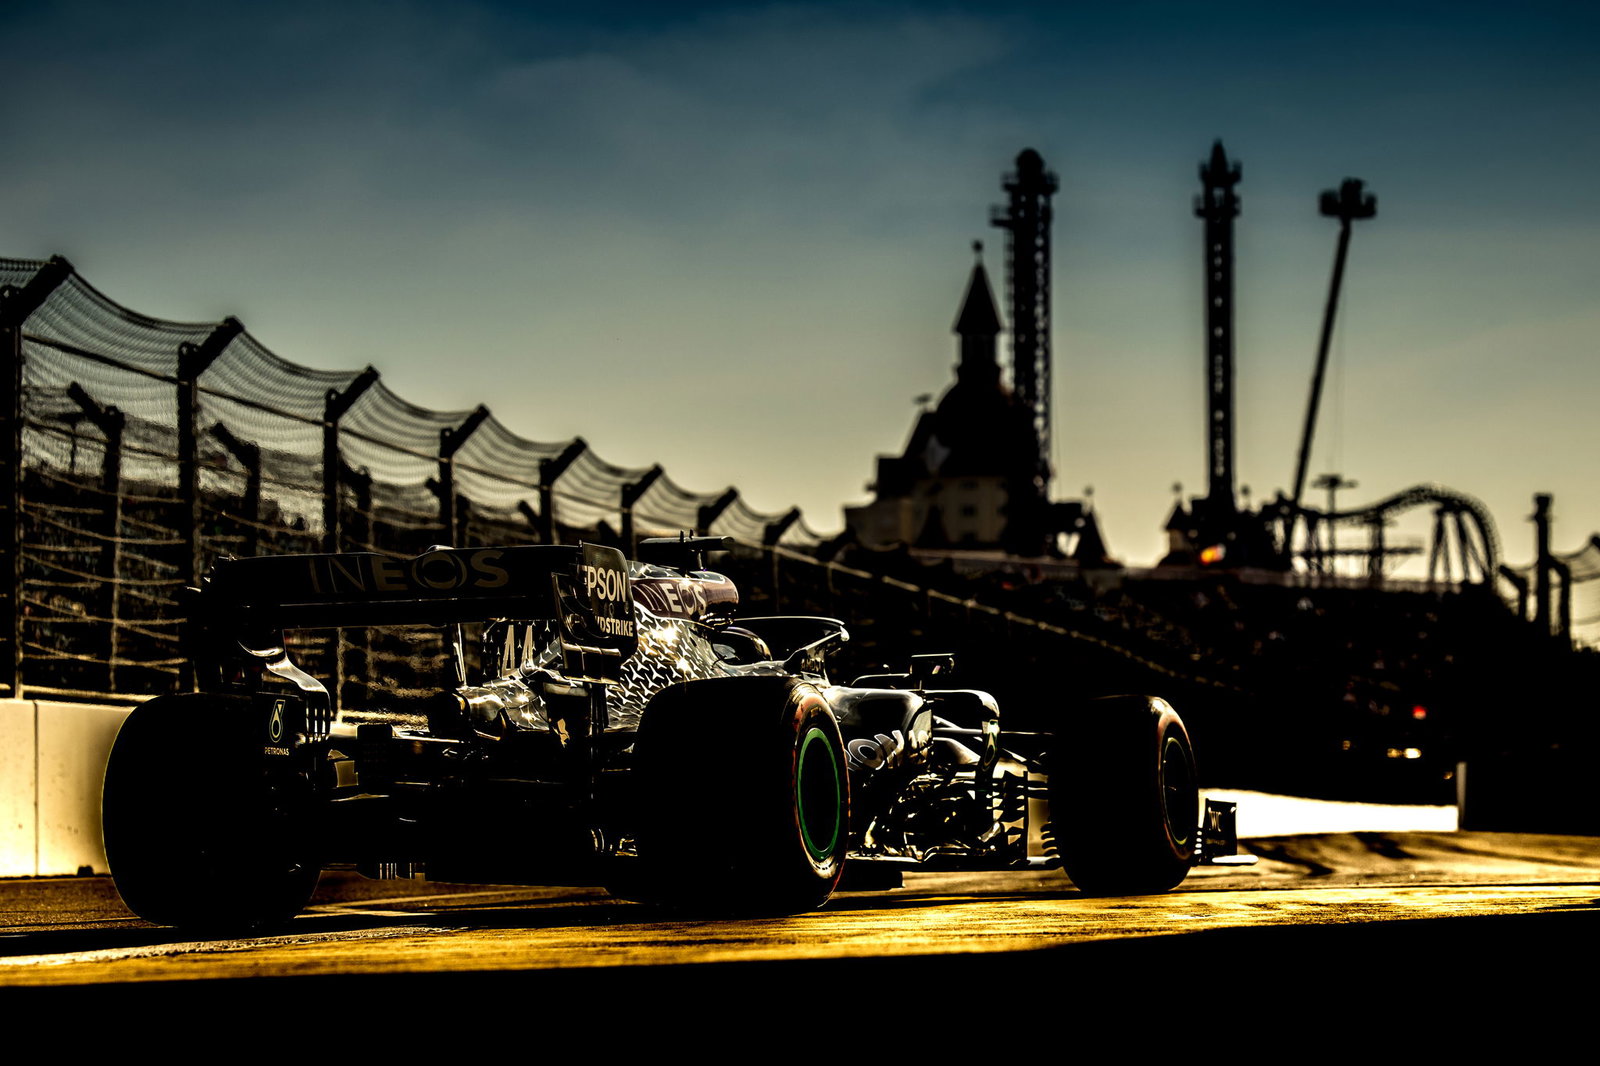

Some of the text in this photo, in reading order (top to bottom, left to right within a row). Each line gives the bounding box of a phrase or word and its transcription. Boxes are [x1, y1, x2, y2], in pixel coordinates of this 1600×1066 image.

[308, 549, 510, 593] INEOS
[631, 582, 707, 615] INEOS
[502, 624, 534, 680] 44
[264, 747, 290, 756] PETRONAS
